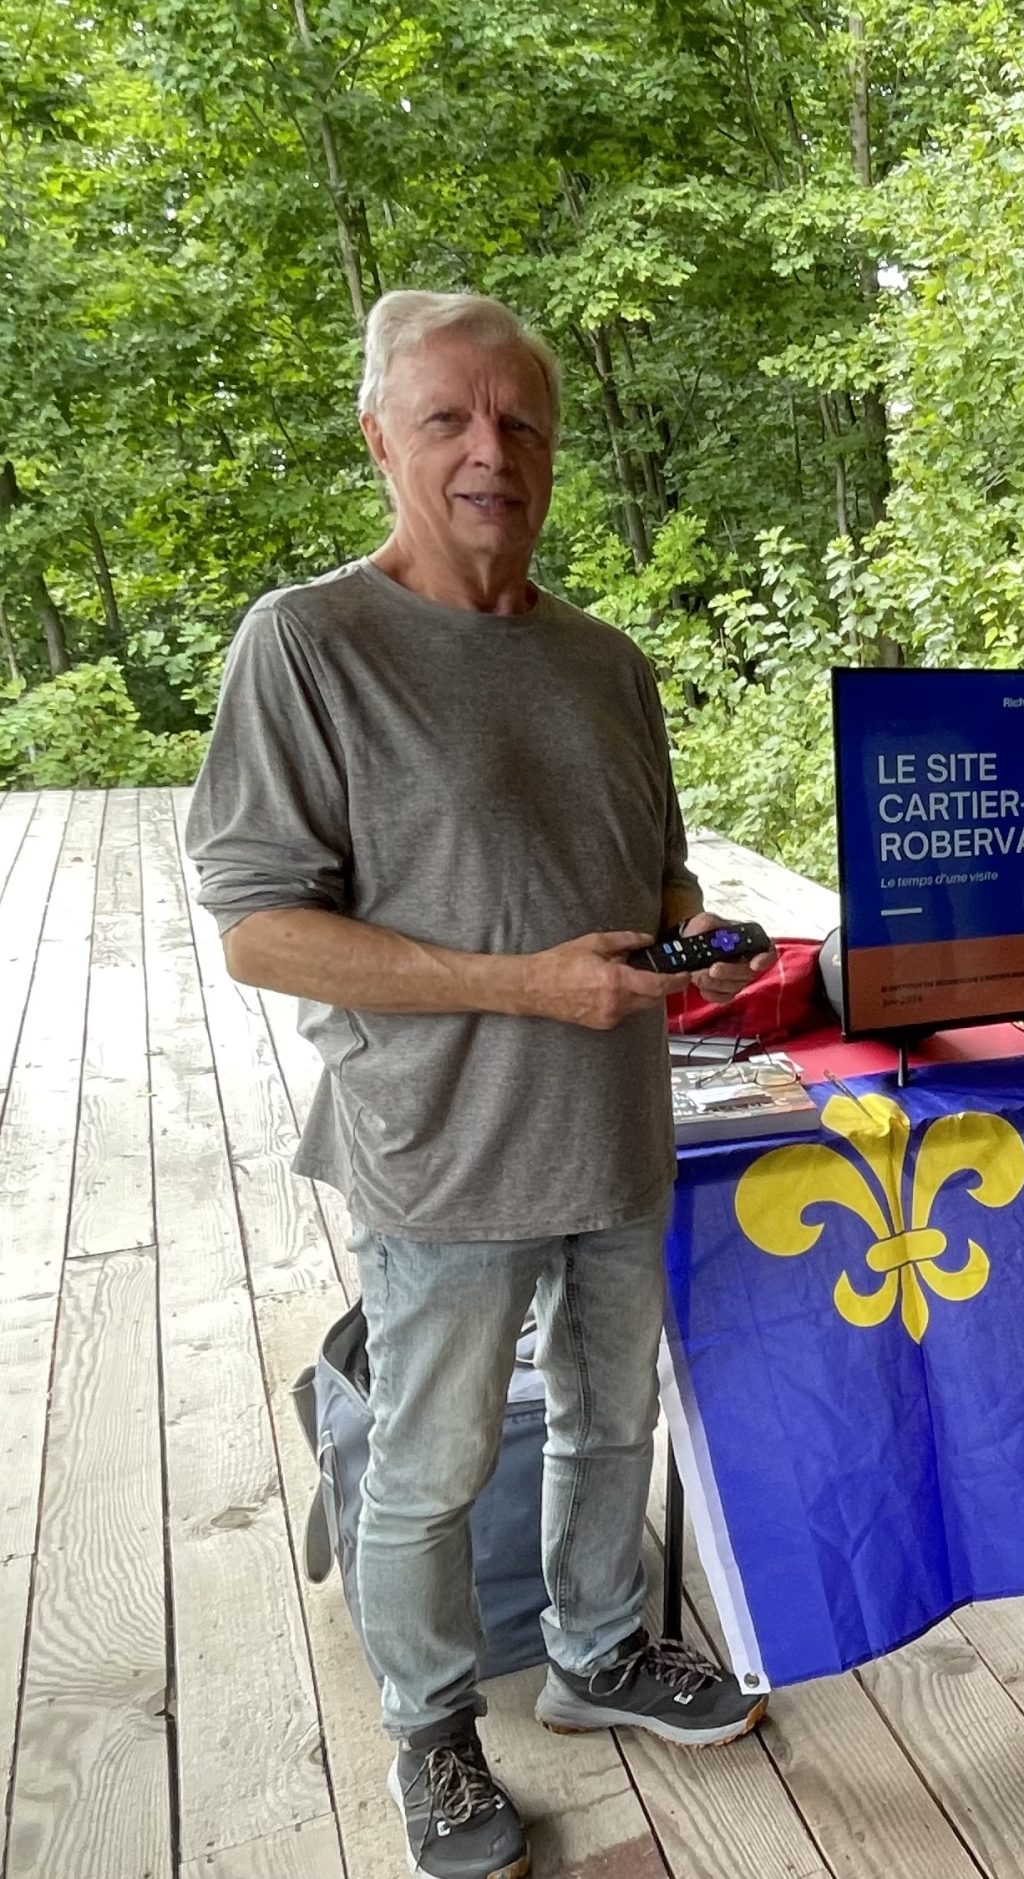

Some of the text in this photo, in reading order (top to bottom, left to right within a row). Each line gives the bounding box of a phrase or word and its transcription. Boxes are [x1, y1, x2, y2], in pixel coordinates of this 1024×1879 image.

[878, 753, 998, 784] LE SITE
[880, 877, 895, 889] Le
[897, 874, 933, 888] temps
[969, 870, 998, 882] visite
